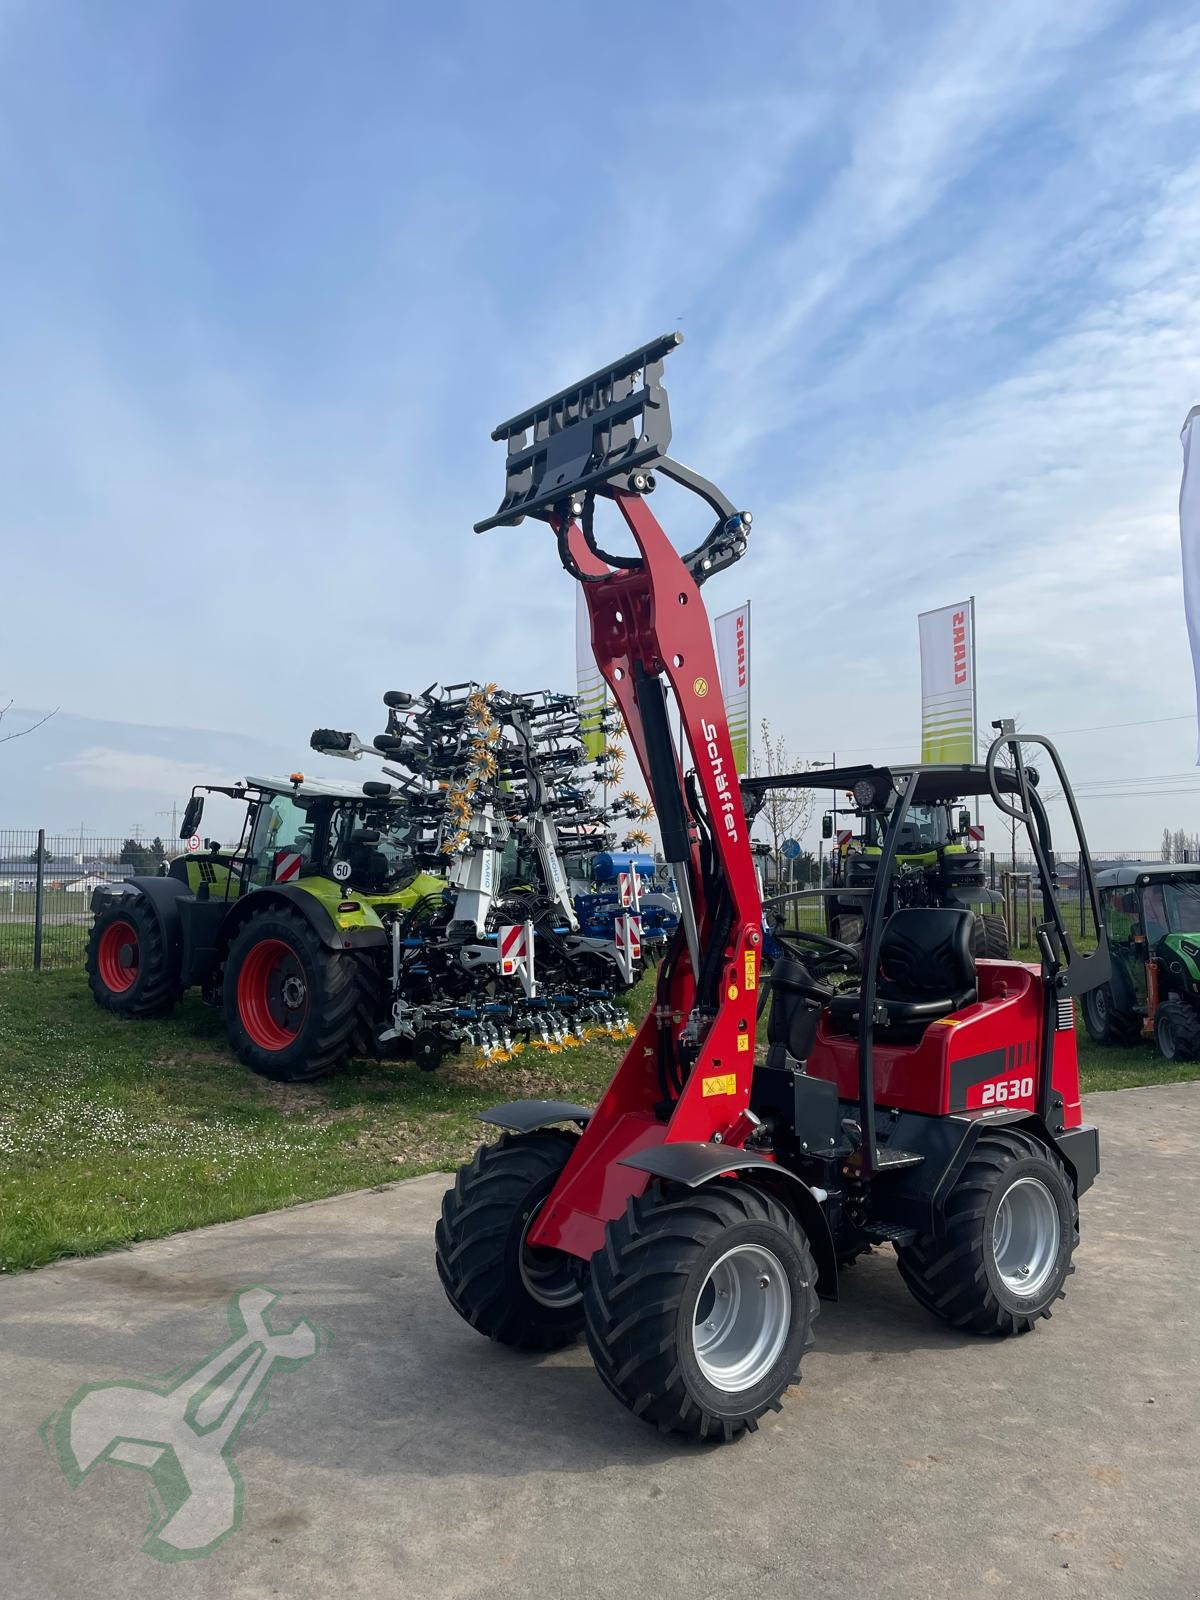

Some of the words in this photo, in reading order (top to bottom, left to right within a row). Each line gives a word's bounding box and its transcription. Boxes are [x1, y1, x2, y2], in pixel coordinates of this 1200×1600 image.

[701, 718, 738, 843] Schäffer
[336, 864, 349, 877] 50
[982, 1077, 1033, 1105] 2630
